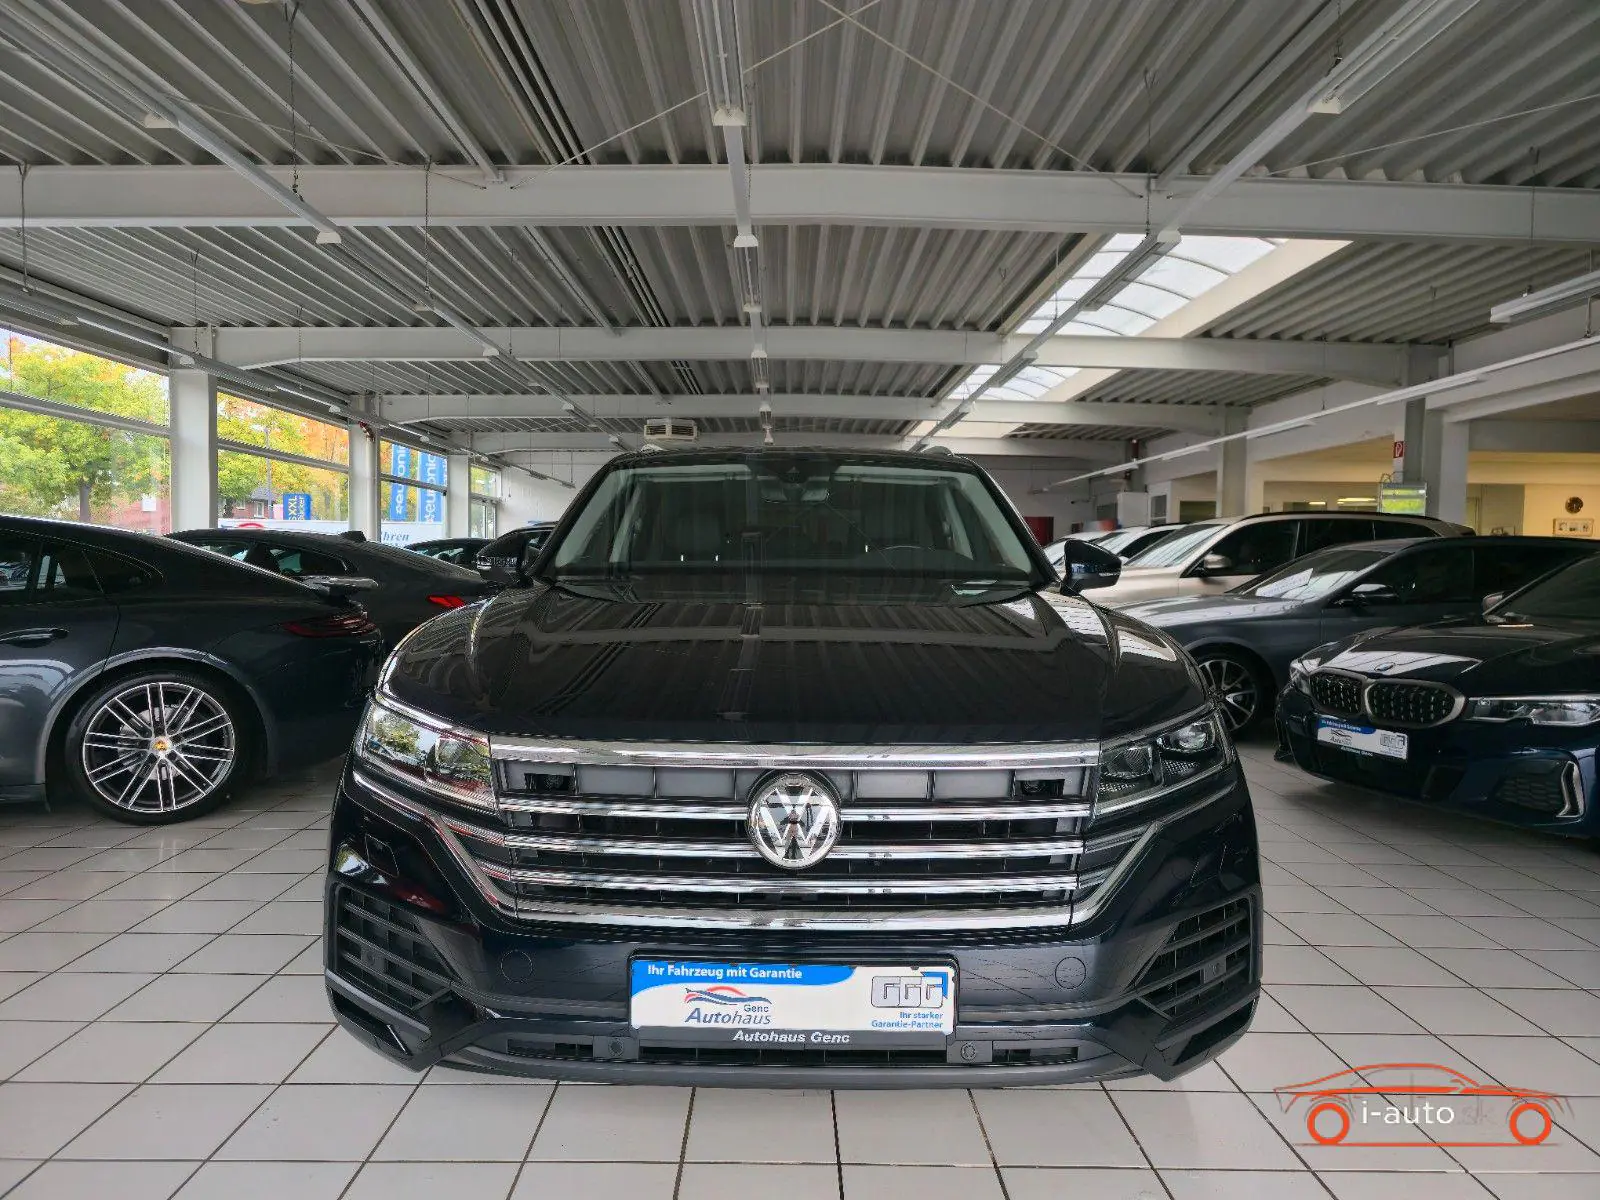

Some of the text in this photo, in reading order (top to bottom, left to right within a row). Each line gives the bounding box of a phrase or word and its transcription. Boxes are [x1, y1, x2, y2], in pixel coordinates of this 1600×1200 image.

[647, 965, 803, 980] Ihr Fahrzeug mit Garantie
[743, 1004, 770, 1014] Genc
[684, 1007, 772, 1026] Autohaus
[899, 1011, 912, 1020] Ihr
[870, 1019, 944, 1029] Garantie-Partner
[732, 1030, 850, 1044] Autohaus Genc
